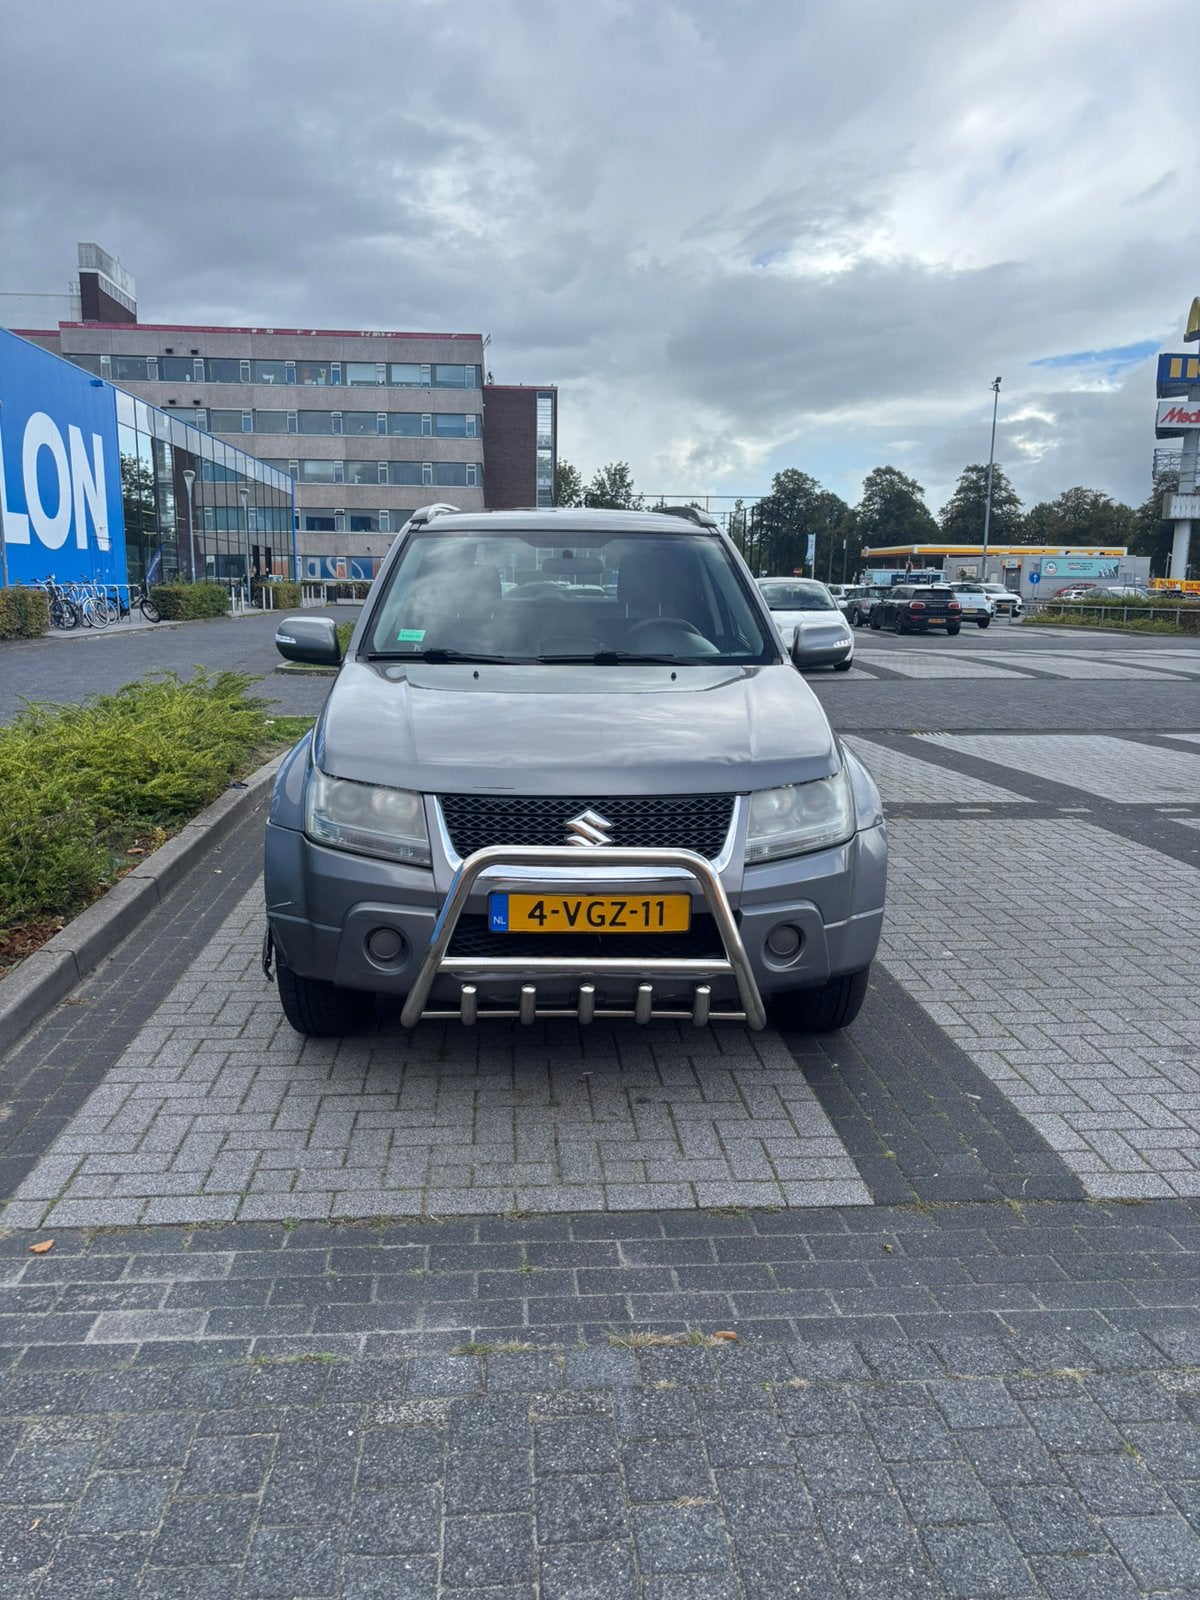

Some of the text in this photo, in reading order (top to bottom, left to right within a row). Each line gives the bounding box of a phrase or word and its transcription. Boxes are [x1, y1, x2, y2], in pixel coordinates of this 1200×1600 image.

[0, 411, 110, 552] LON
[493, 916, 506, 925] NL
[527, 900, 665, 927] 4-VGZ-11
